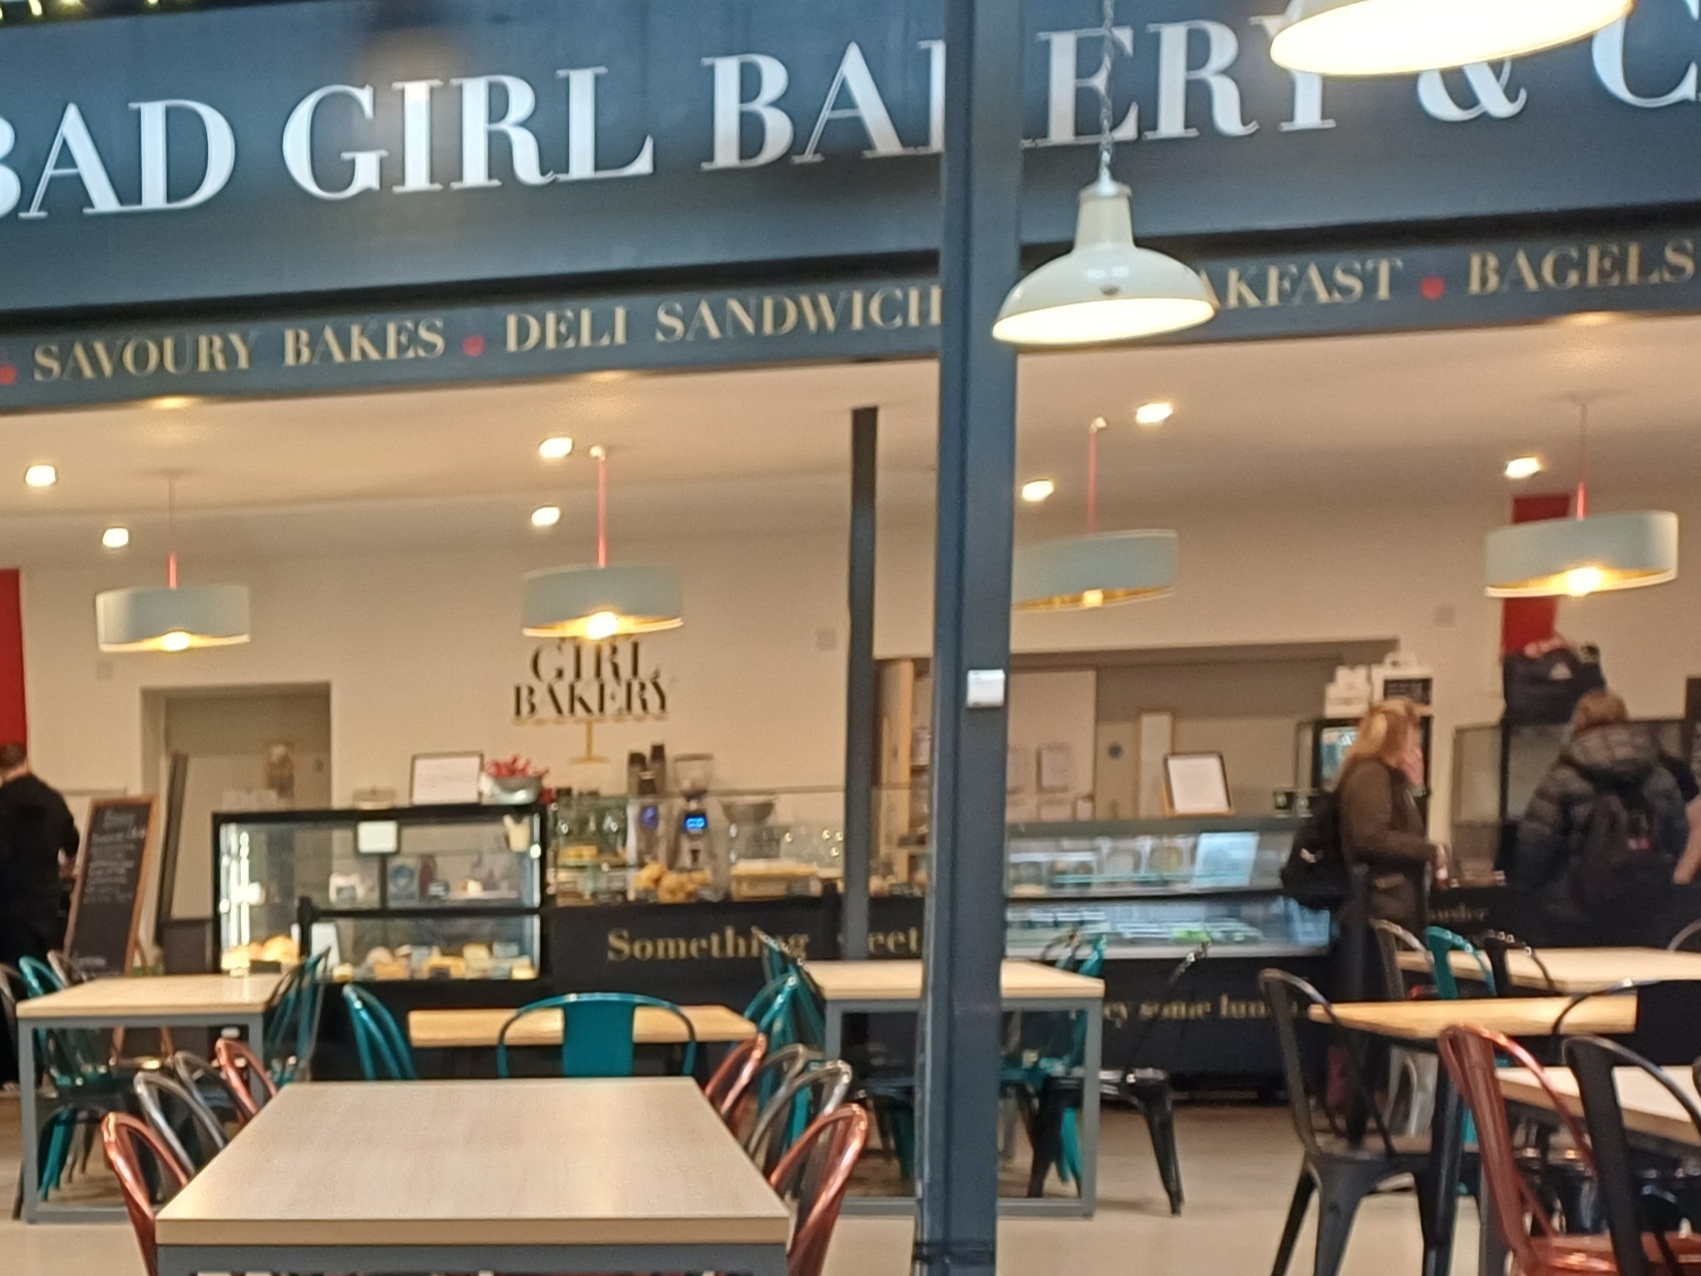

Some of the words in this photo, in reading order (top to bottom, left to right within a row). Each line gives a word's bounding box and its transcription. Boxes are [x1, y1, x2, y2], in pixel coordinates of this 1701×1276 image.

[282, 66, 654, 200] GIRL
[33, 330, 258, 382] SAVOURY
[283, 318, 445, 368] BAKES
[505, 305, 627, 353] DELI
[1467, 236, 1698, 297] BAGELS
[513, 680, 669, 718] BAKERY
[530, 635, 661, 684] GIRL
